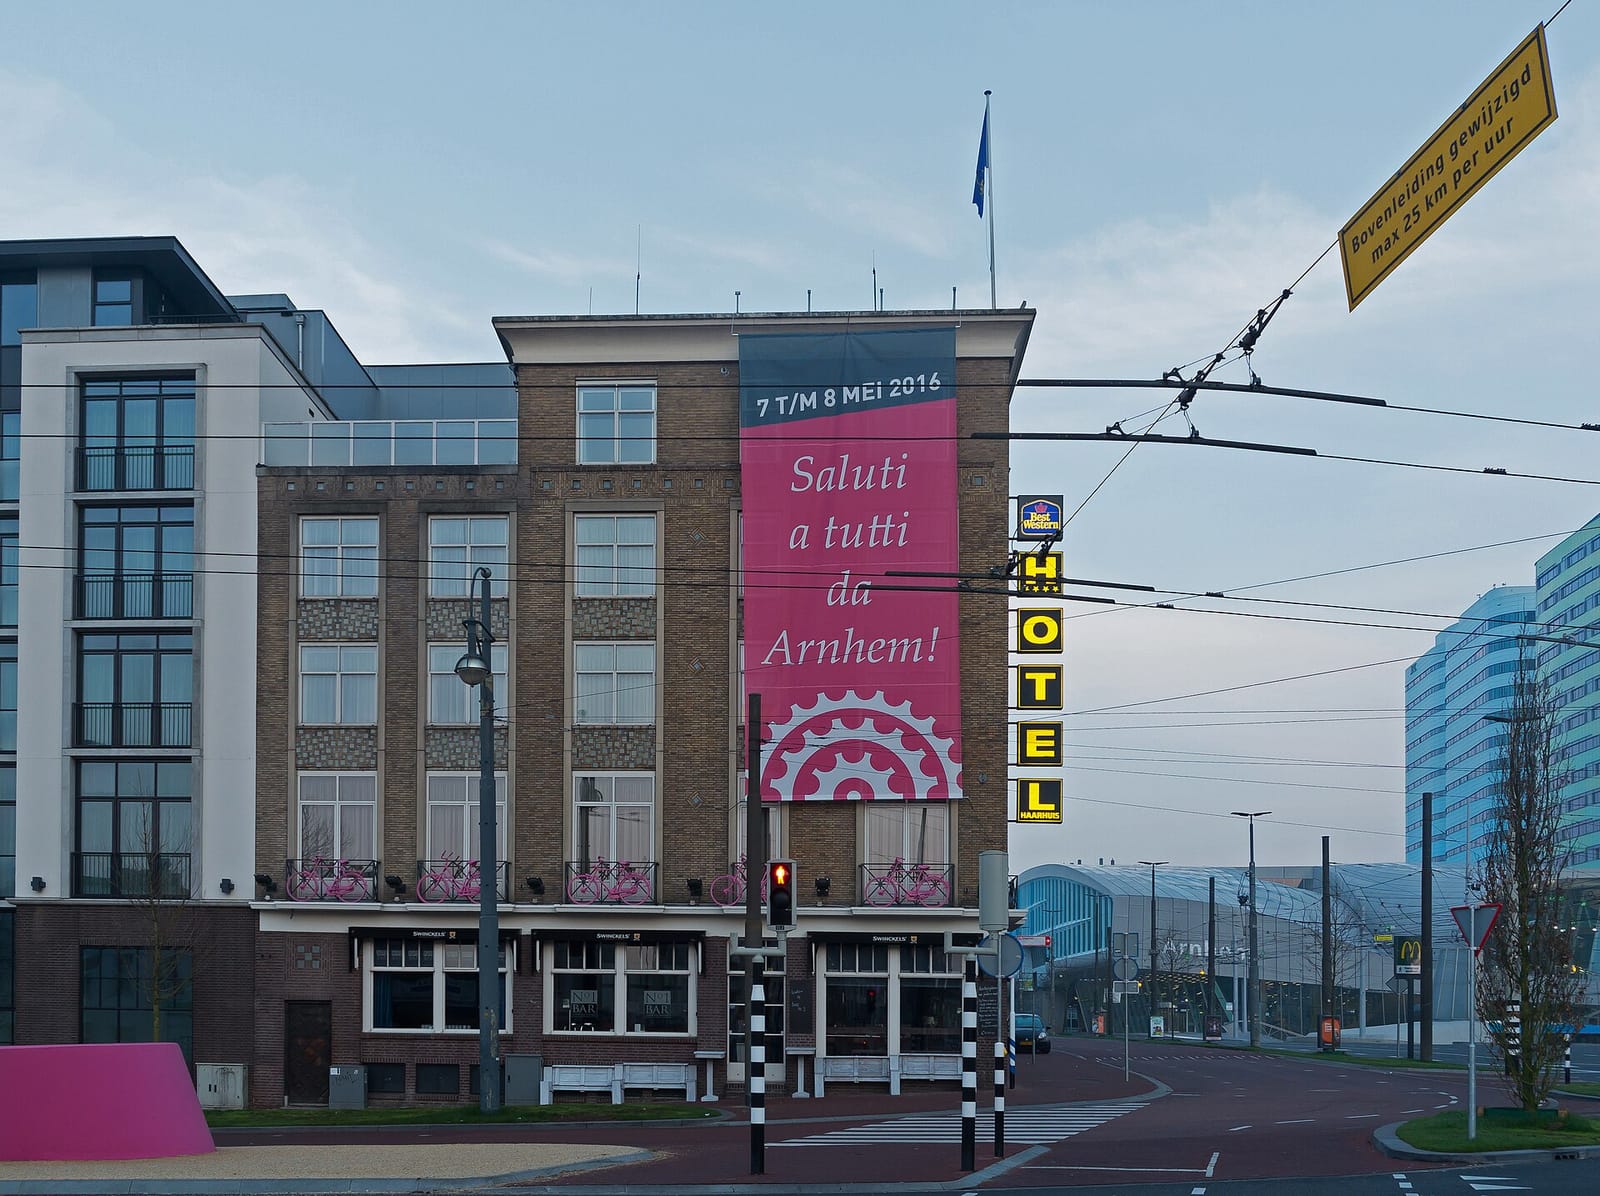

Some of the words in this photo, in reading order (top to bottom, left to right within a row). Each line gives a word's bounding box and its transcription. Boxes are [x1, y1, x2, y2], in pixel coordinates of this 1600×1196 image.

[1351, 153, 1445, 255] Bovenleiding
[1449, 63, 1532, 161] gewijzigd
[1371, 228, 1400, 264] max
[1403, 207, 1421, 232] 25
[1425, 182, 1448, 211] km
[1452, 150, 1479, 190] per
[1484, 117, 1514, 154] uur
[756, 398, 769, 418] 7
[775, 390, 818, 416] T/M
[824, 387, 836, 408] 8
[842, 380, 883, 404] MEI
[889, 371, 941, 399] 2016
[790, 452, 908, 493] Saluti
[789, 522, 809, 551] a
[824, 510, 909, 549] tutti
[1023, 520, 1059, 530] Western
[1030, 512, 1051, 523] Best
[826, 569, 872, 607] da
[761, 626, 940, 665] Arnhem!
[1022, 556, 1059, 811] HOTEL
[1020, 811, 1060, 820] HAARHUIS
[572, 1004, 596, 1014] BAR
[645, 1005, 669, 1015] BAR
